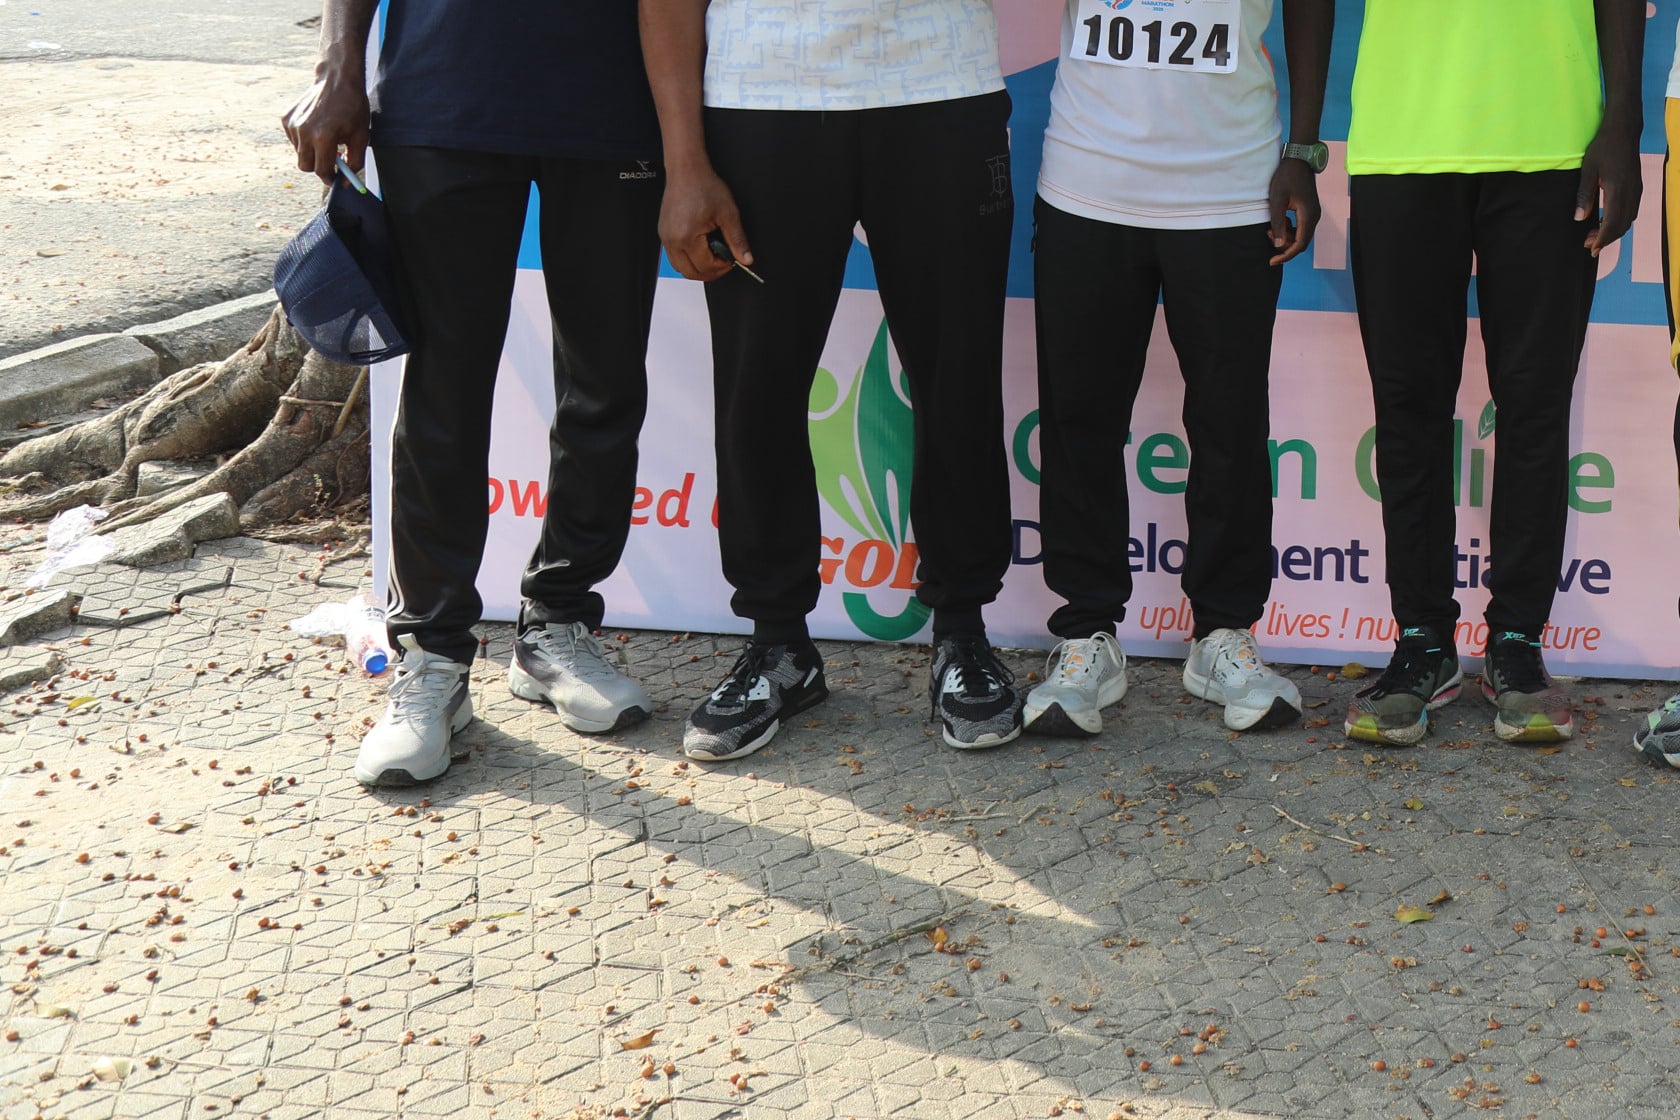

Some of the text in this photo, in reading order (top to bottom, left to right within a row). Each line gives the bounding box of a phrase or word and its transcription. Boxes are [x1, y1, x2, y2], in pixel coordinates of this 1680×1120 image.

[1083, 14, 1231, 67] 10124
[1267, 602, 1331, 638] lives
[1337, 607, 1349, 638] !
[1542, 620, 1600, 652] ture
